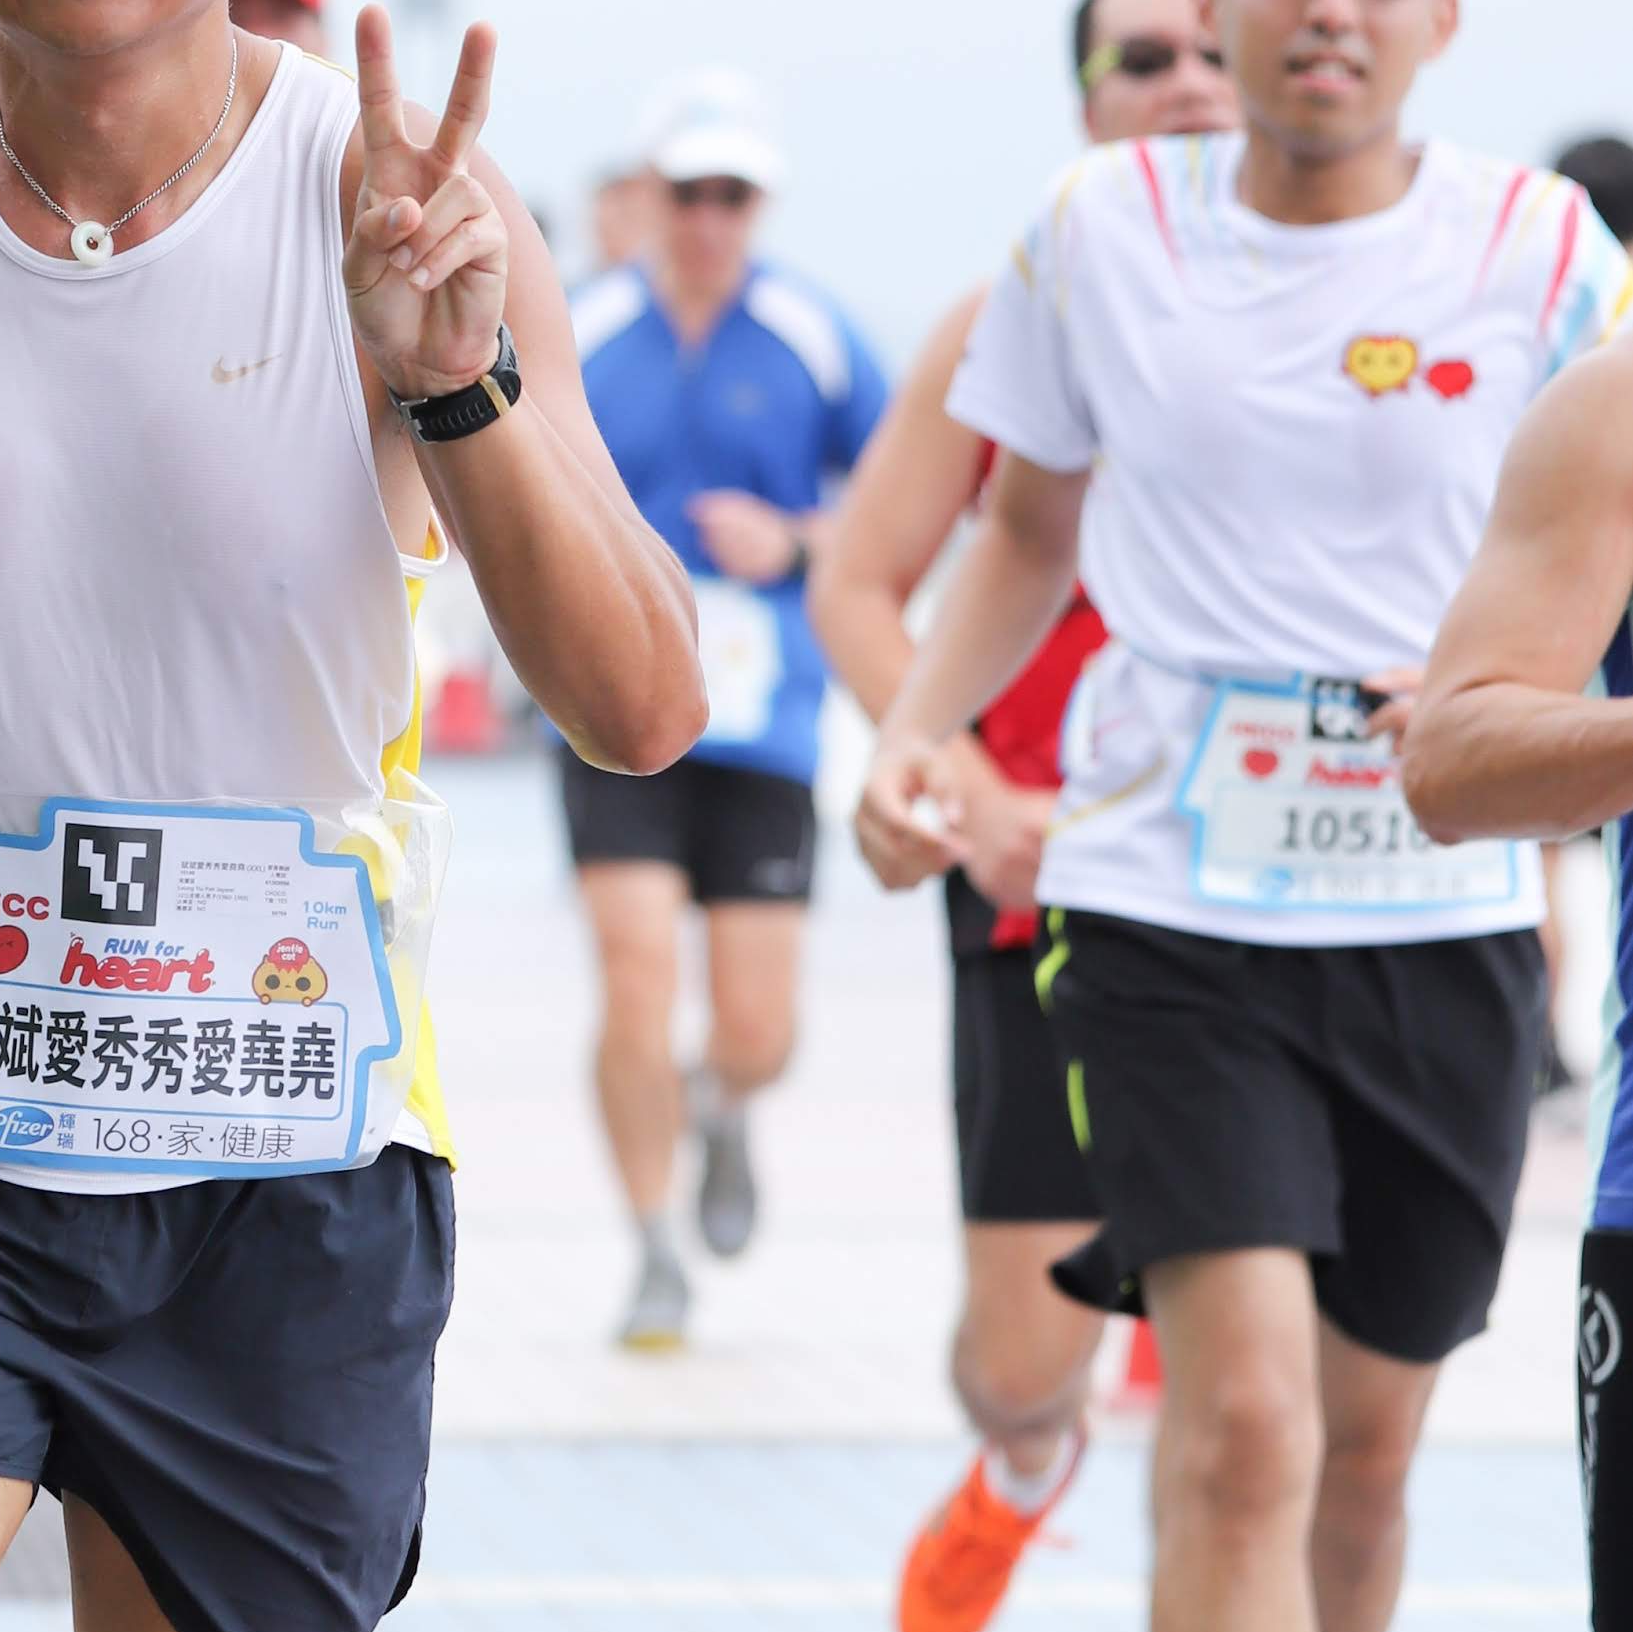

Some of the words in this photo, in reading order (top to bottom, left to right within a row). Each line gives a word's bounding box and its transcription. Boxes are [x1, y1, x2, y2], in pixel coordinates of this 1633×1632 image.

[304, 900, 347, 915] 10km
[307, 916, 339, 930] Run
[104, 938, 149, 956] RUN
[154, 940, 185, 957] for
[60, 936, 216, 994] heart
